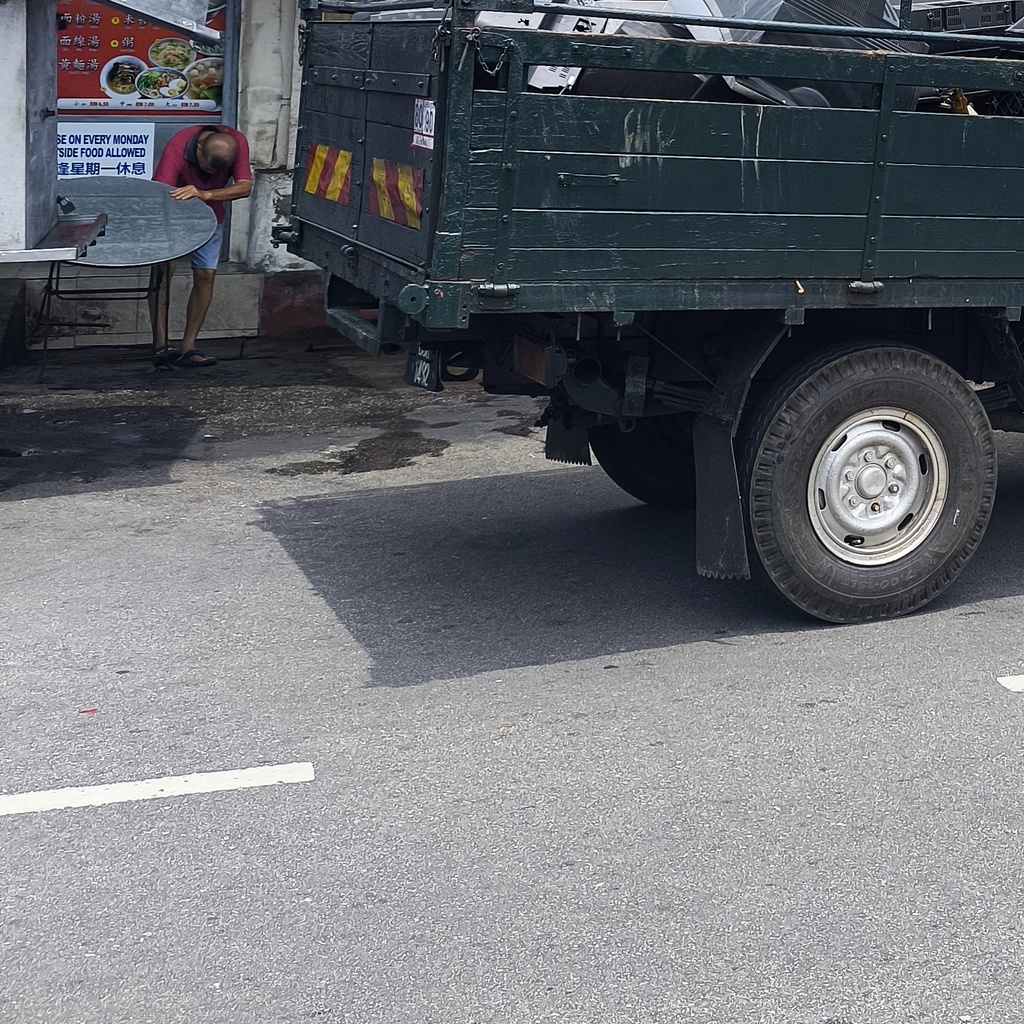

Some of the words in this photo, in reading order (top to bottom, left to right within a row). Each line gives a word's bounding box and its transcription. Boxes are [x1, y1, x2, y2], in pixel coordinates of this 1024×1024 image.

[68, 134, 82, 145] ON
[83, 134, 112, 145] EVERY
[113, 134, 149, 145] MONDAY
[80, 147, 104, 158] FOOD
[105, 147, 146, 158] ALLOWED
